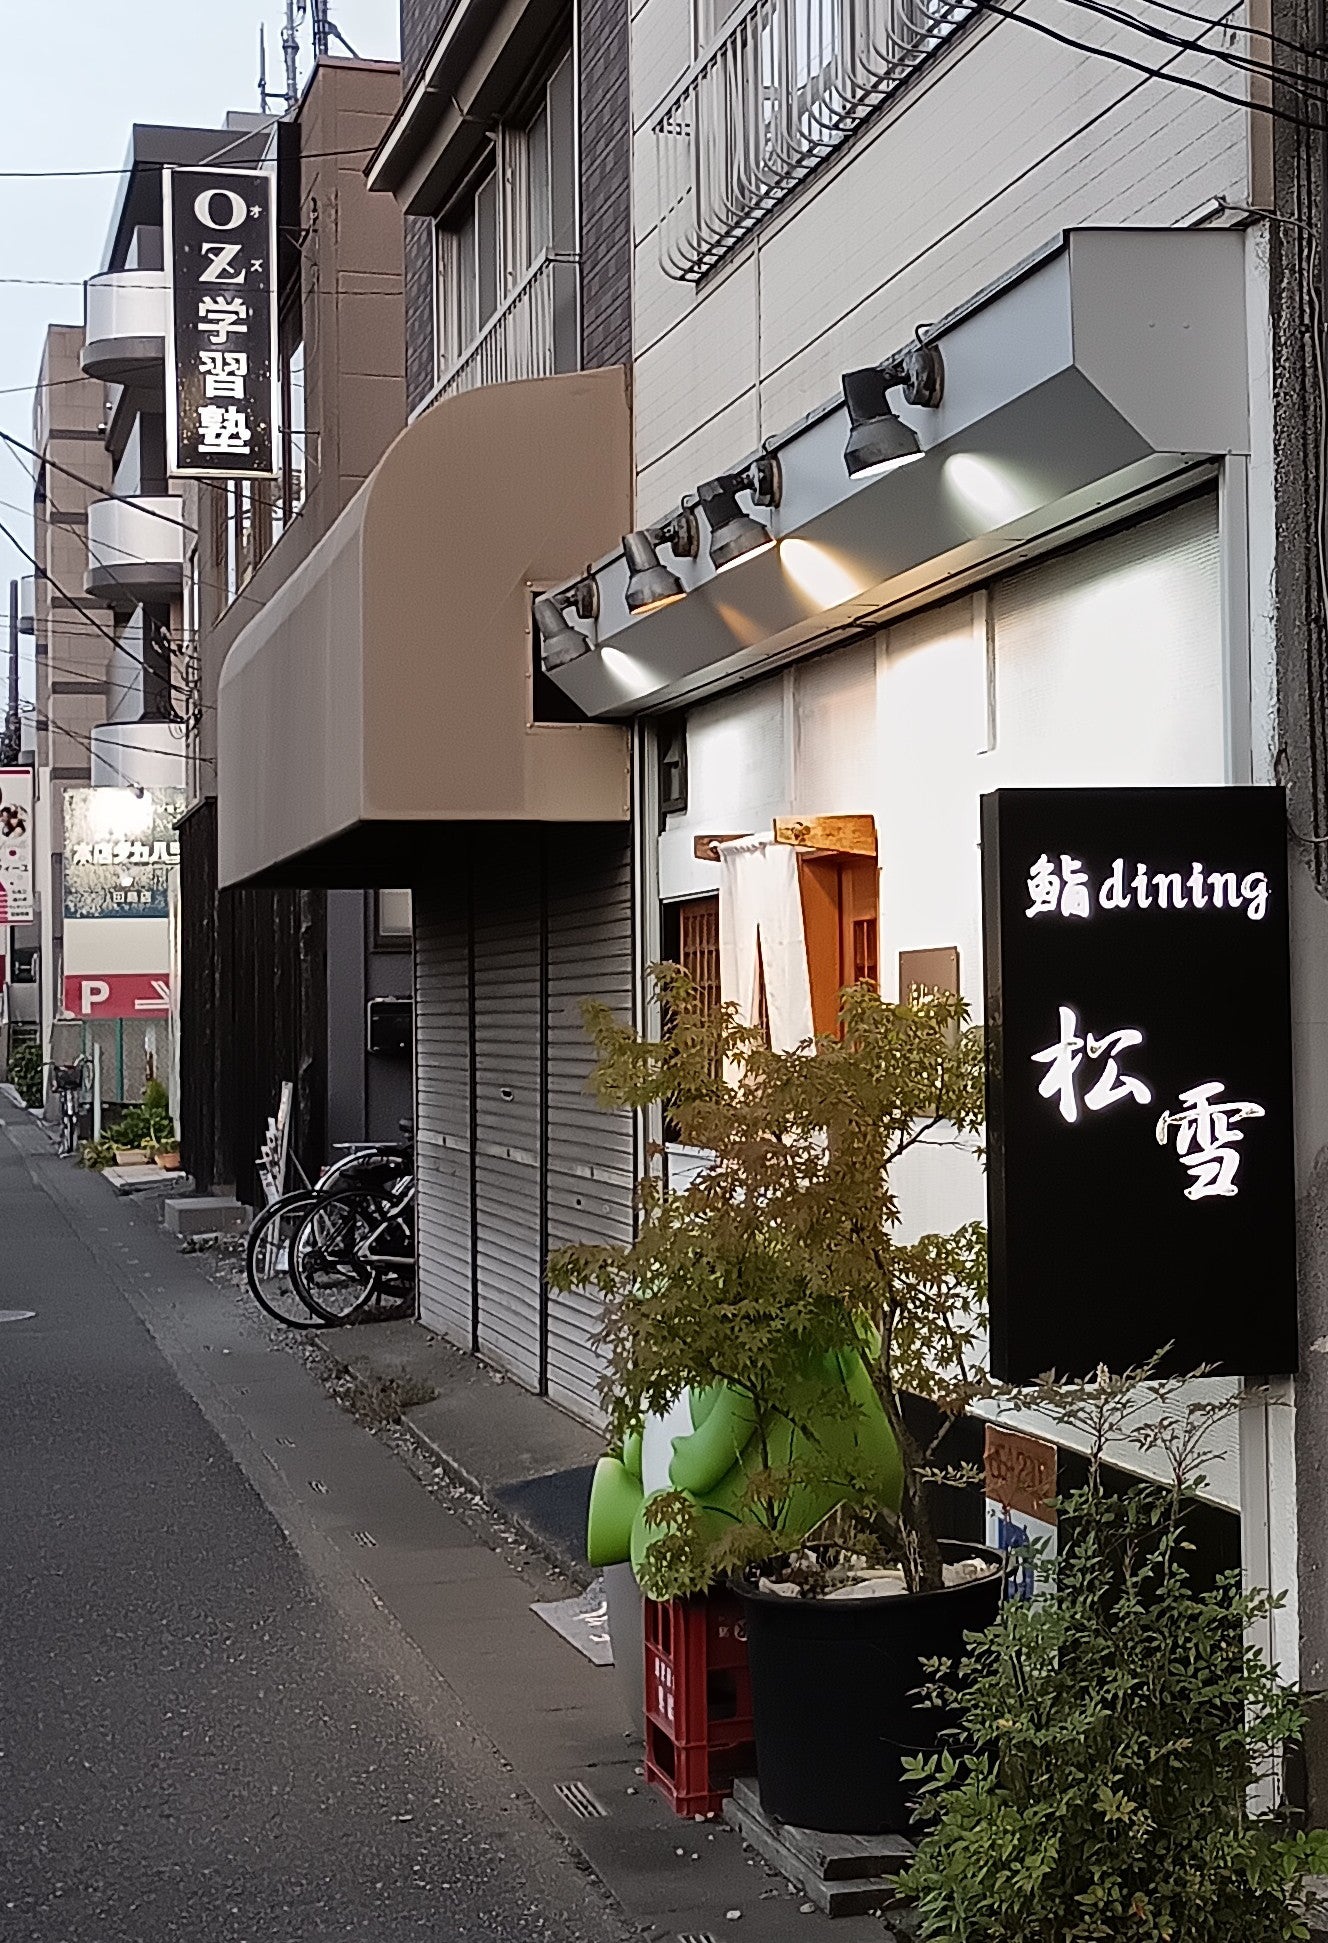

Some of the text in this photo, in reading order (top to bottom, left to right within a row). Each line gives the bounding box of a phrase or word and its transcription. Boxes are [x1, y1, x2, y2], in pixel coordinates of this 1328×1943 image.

[195, 189, 251, 454] OZ学習塾
[81, 981, 110, 1015] P
